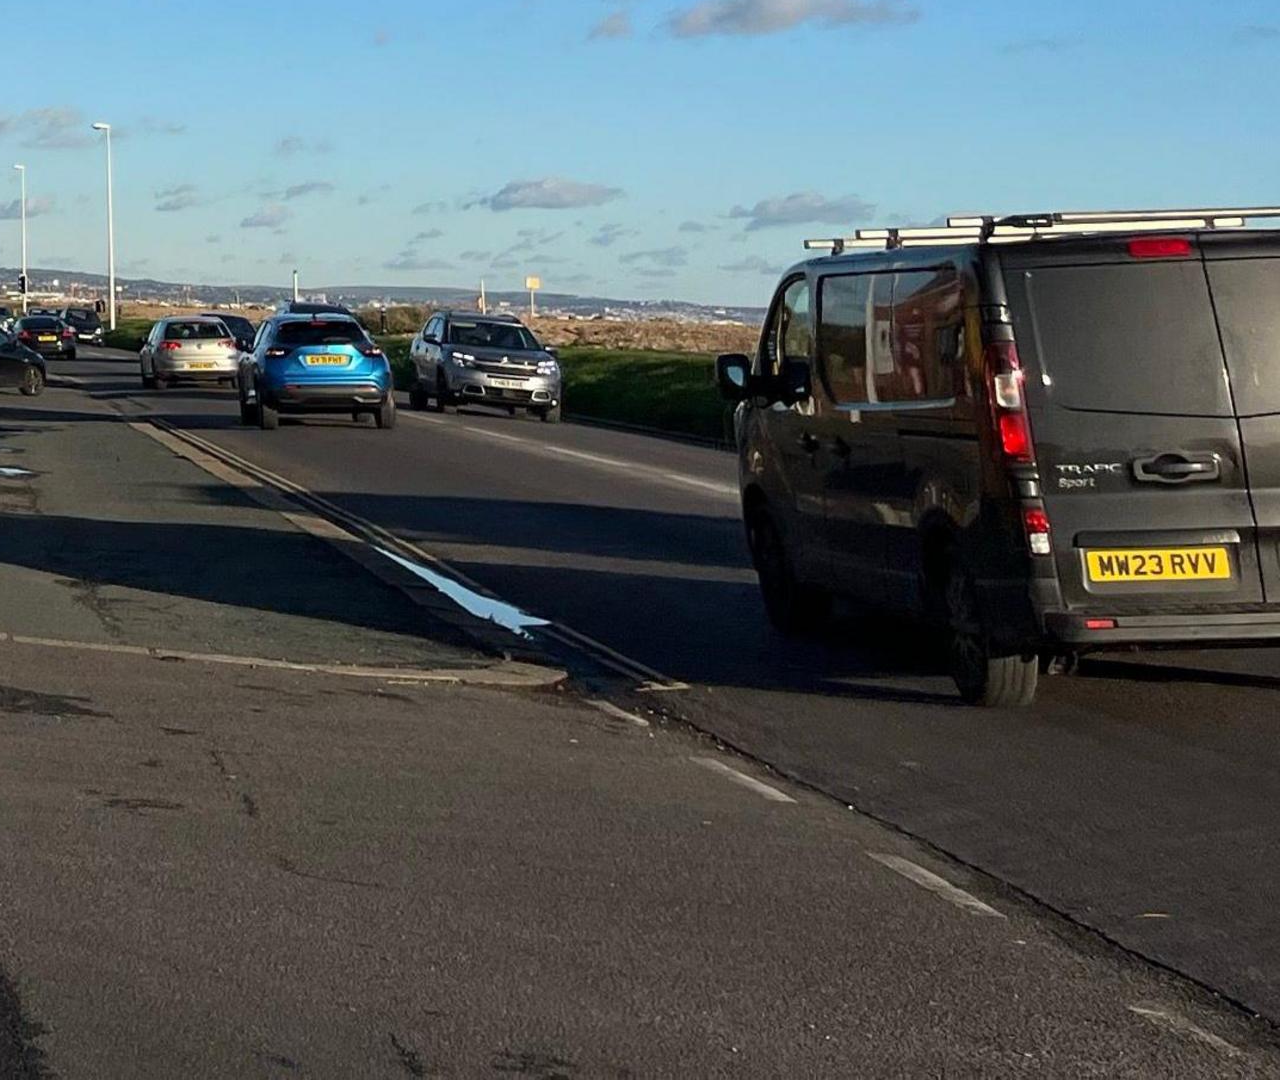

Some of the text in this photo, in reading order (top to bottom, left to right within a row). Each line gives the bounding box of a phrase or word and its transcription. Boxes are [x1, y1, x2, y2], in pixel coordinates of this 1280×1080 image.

[1058, 476, 1096, 489] Sport
[1098, 552, 1216, 577] MW23 RVV
